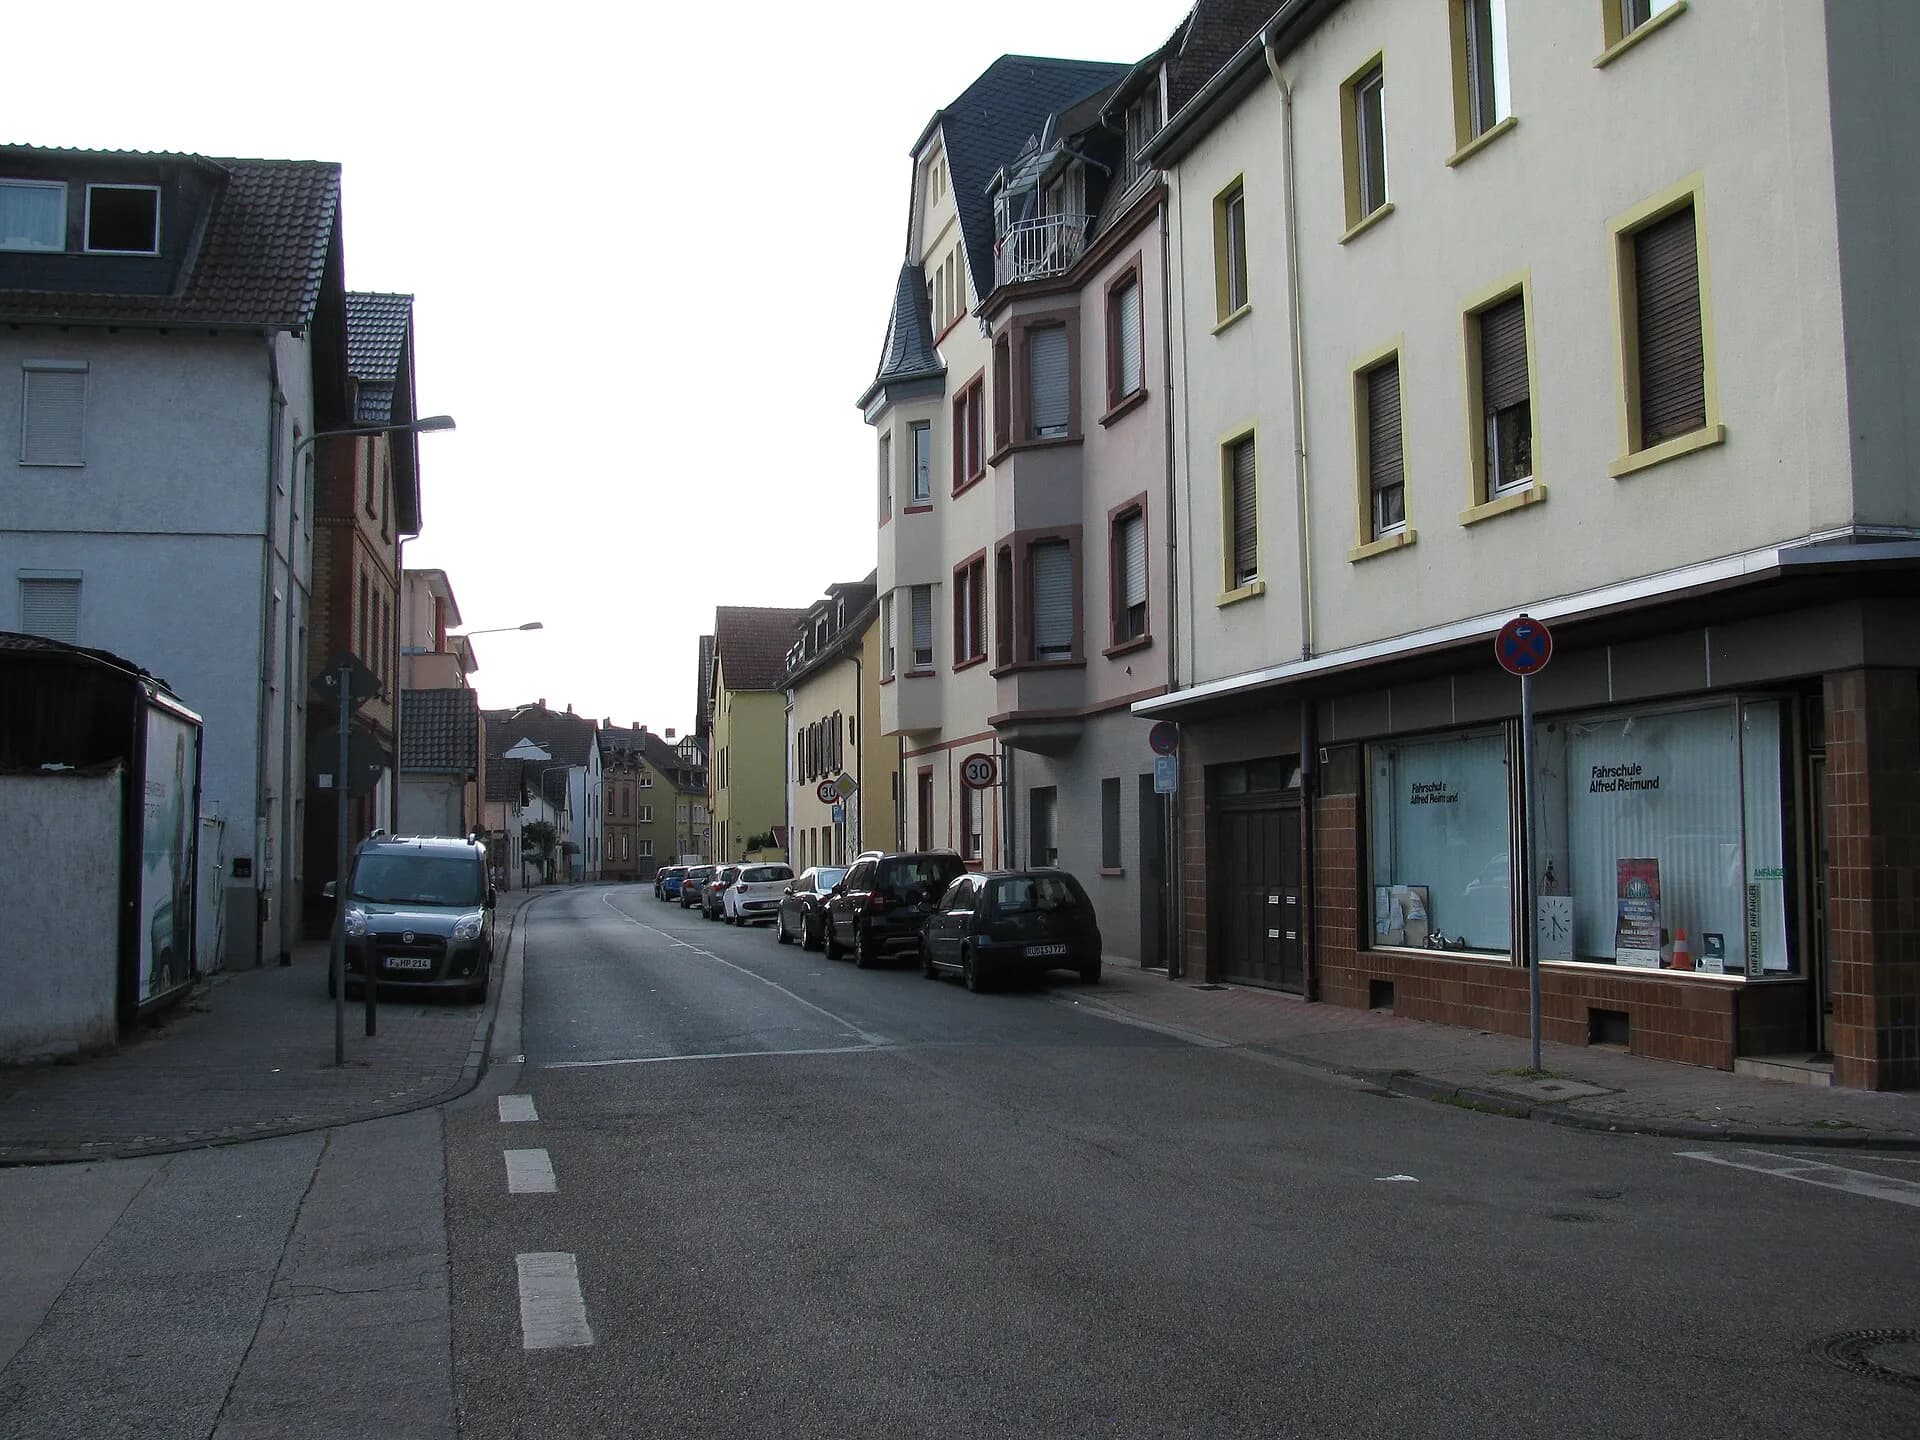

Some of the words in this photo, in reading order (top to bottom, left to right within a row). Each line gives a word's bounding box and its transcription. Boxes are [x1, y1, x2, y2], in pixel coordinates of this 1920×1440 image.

[968, 763, 989, 780] 30
[1592, 763, 1642, 779] Fahrschule
[822, 785, 836, 798] 30
[1411, 780, 1447, 793] Fahrschule
[1589, 779, 1616, 793] Alfred
[1618, 776, 1659, 791] Reimund
